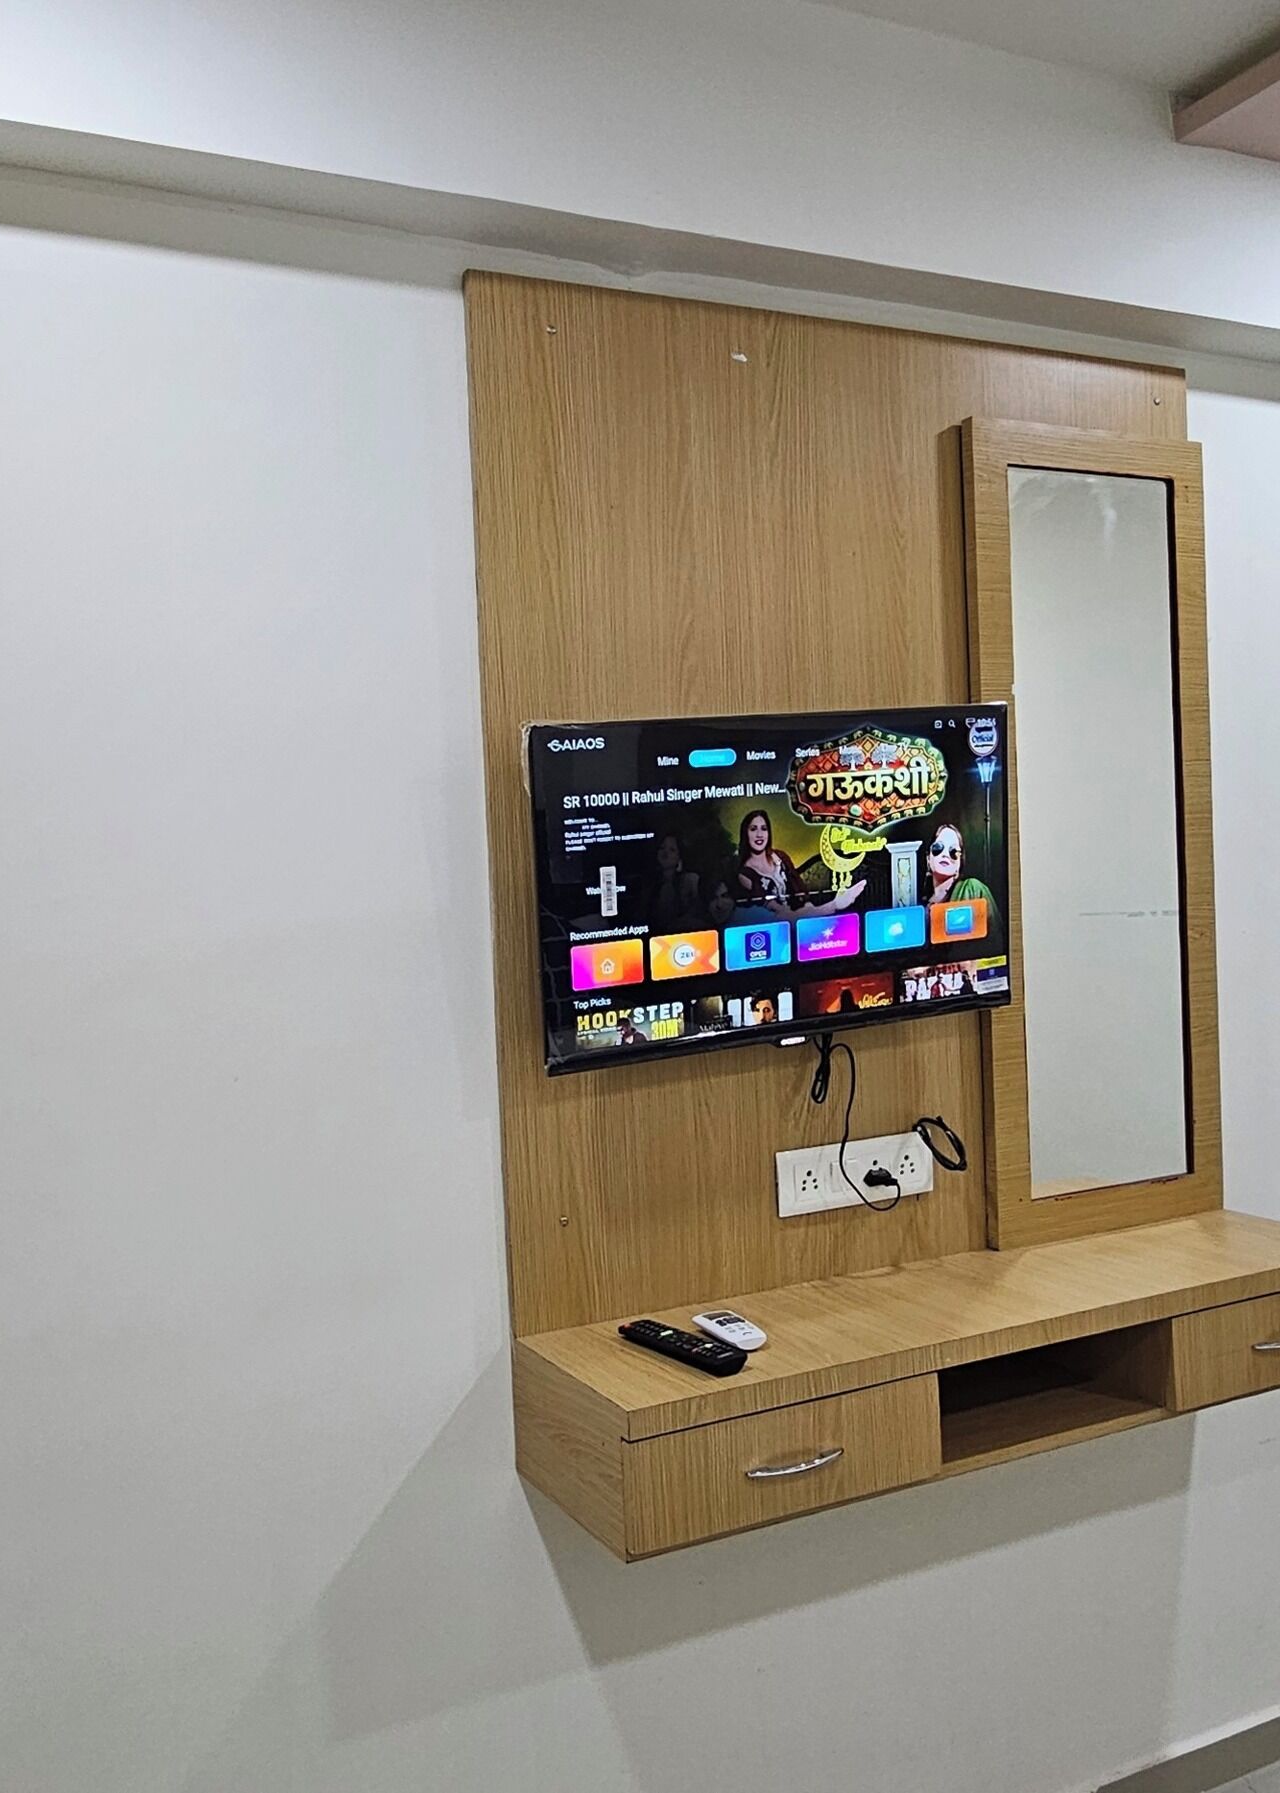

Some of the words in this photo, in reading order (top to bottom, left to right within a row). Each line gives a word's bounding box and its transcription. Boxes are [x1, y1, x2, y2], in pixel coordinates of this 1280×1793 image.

[657, 756, 680, 766] Mine
[746, 751, 776, 761] Movies
[795, 748, 821, 758] Series
[563, 796, 580, 809] SR
[583, 793, 620, 807] 10000
[632, 789, 664, 804] Rahul
[666, 788, 702, 803] Singer
[704, 784, 744, 799] Mewati
[570, 927, 628, 941] Recommended
[628, 925, 649, 936] Apps
[573, 1000, 587, 1010] Top
[590, 998, 612, 1008] Picks
[633, 1002, 684, 1023] STEP
